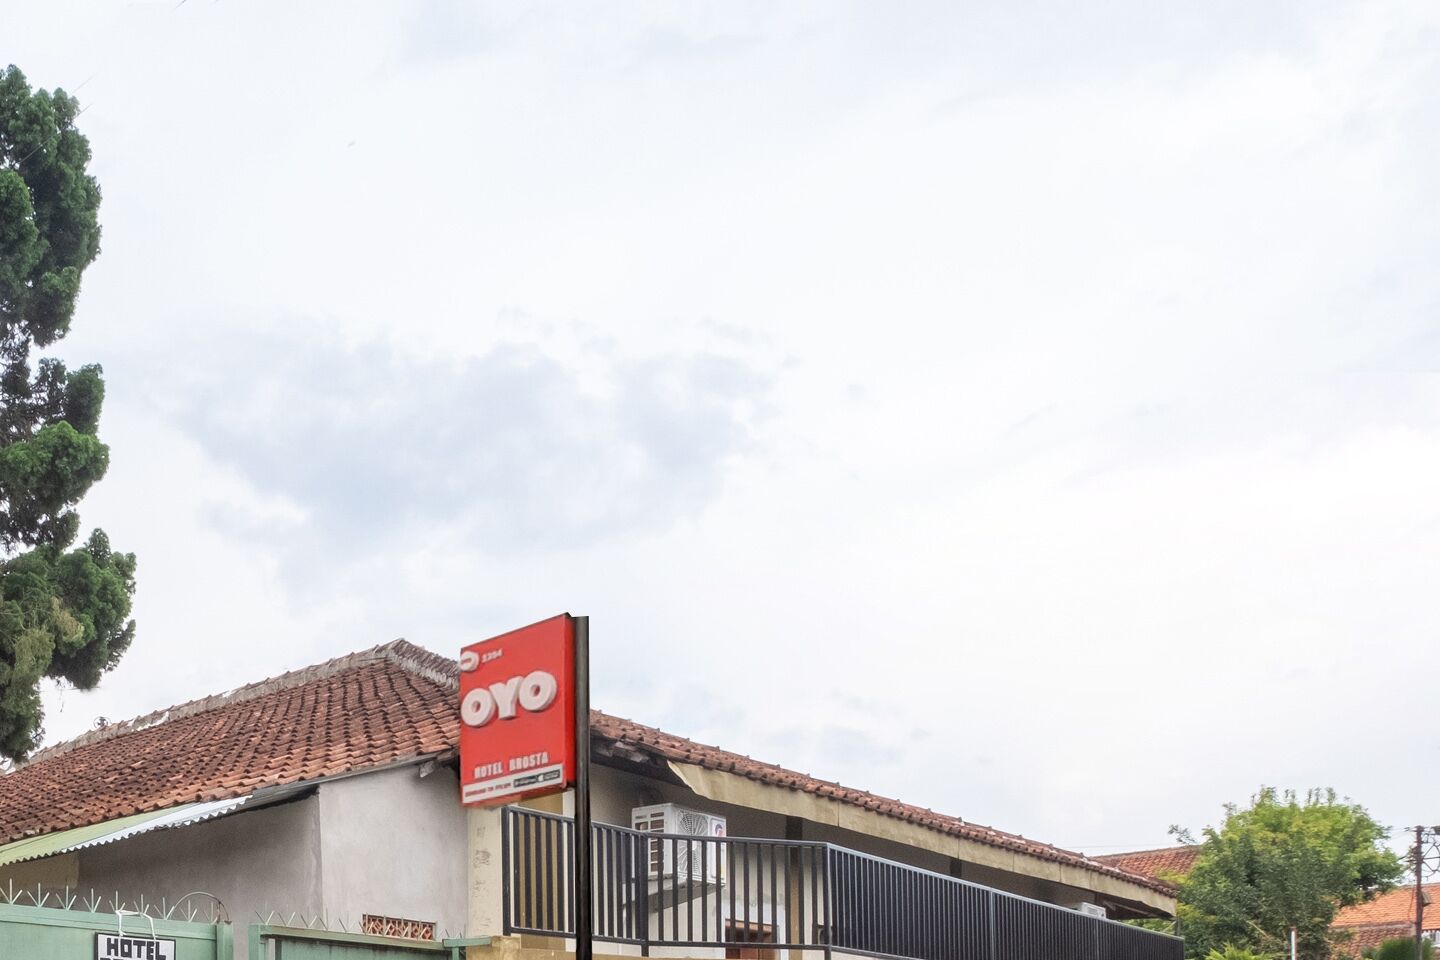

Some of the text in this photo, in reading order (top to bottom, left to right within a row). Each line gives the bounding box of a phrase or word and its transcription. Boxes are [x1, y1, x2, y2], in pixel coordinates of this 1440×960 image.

[461, 671, 558, 728] OYO
[474, 761, 503, 779] HOTEL
[509, 751, 549, 771] BROSTA
[106, 937, 167, 960] HOTEL
